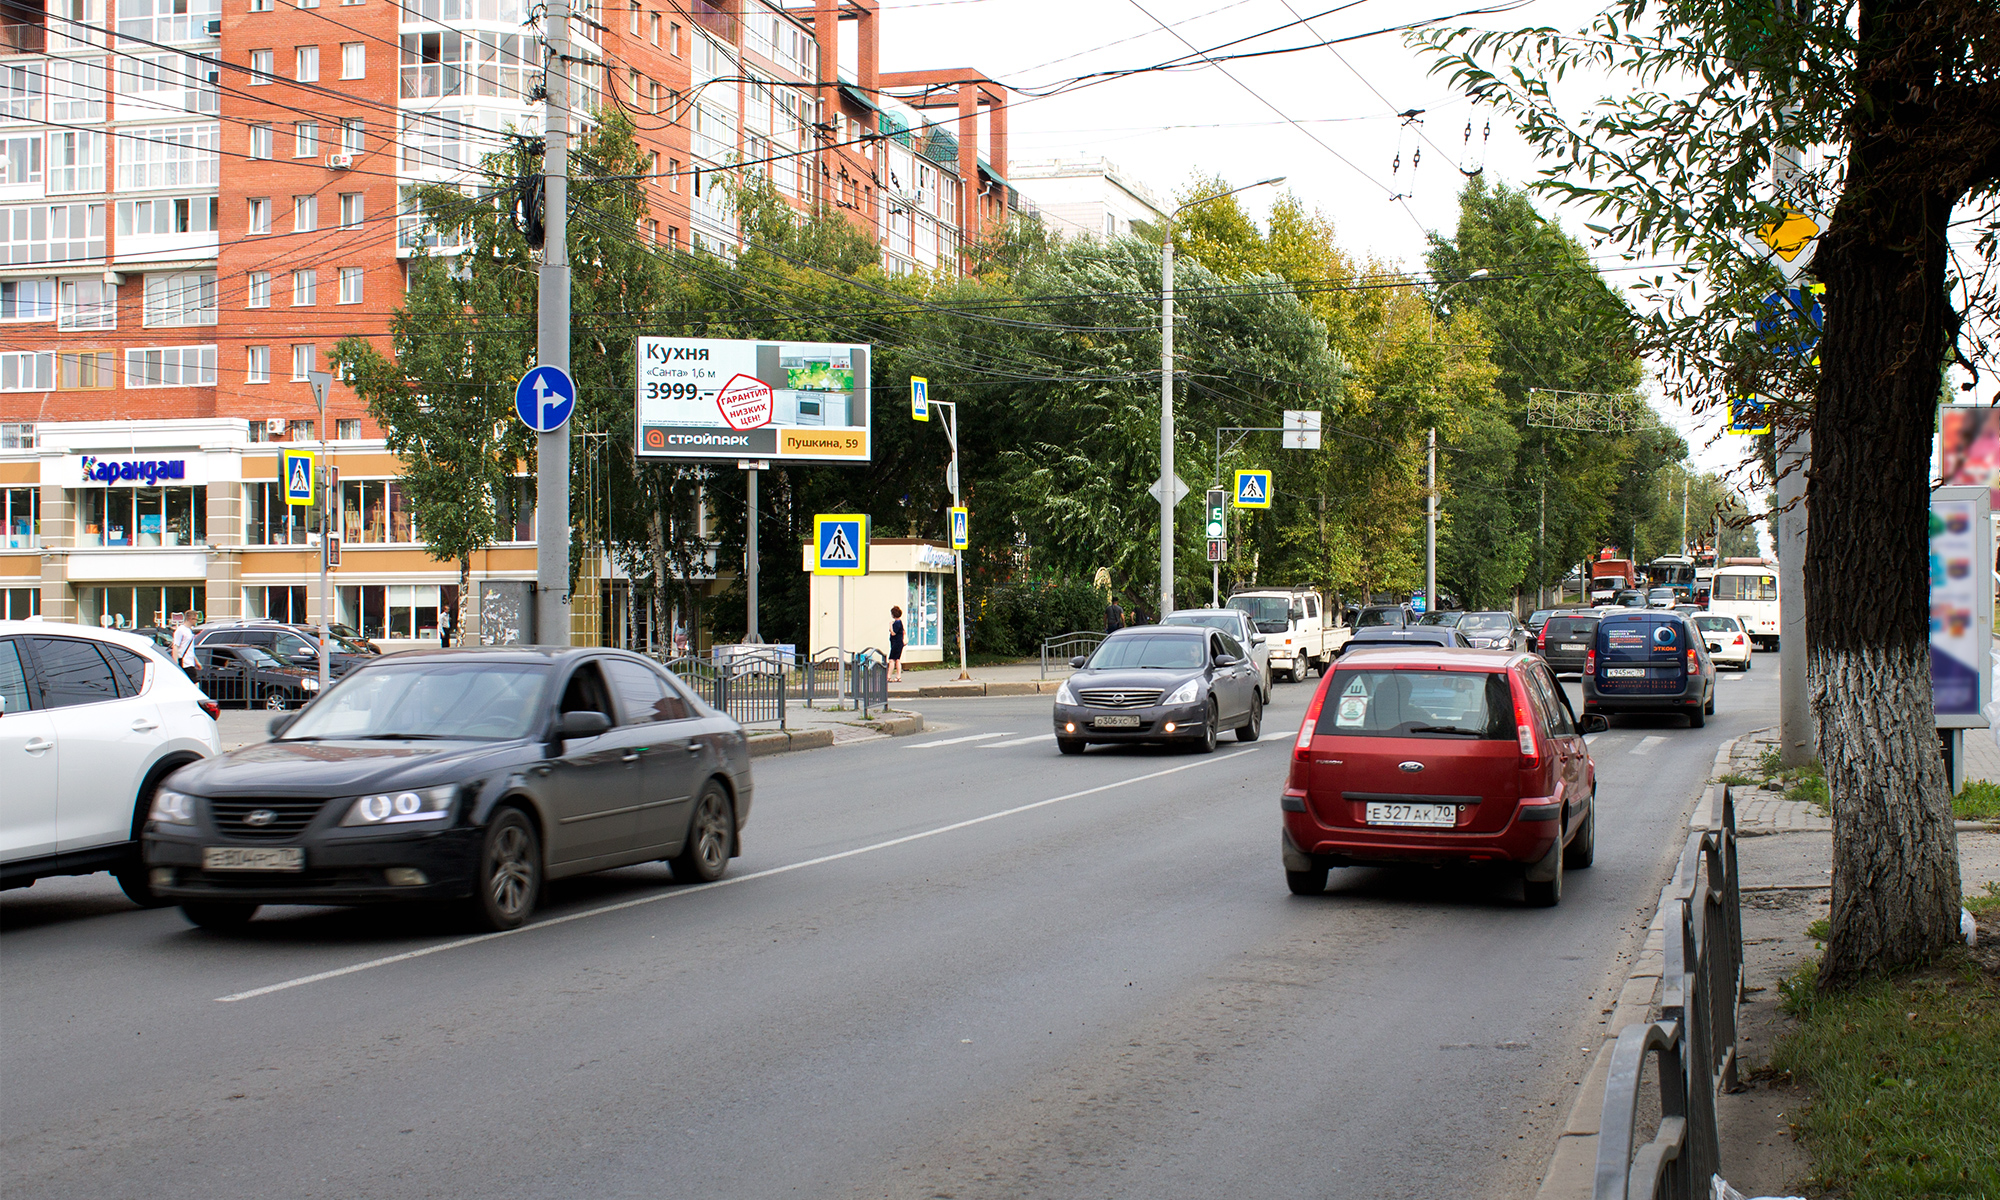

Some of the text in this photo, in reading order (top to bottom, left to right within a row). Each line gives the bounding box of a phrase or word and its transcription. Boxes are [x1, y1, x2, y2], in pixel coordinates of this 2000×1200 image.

[647, 343, 709, 364] Кухня
[646, 366, 688, 377] «Санта»
[692, 368, 705, 379] 1,6
[721, 388, 768, 406] ГАРАНТИЯ
[729, 403, 767, 418] НИЗКИХ
[740, 414, 761, 425] ЦЕН!
[667, 432, 749, 446] СТРОЙПАРК
[787, 437, 859, 449] Пушкина, 59
[82, 455, 185, 486] Карандаш
